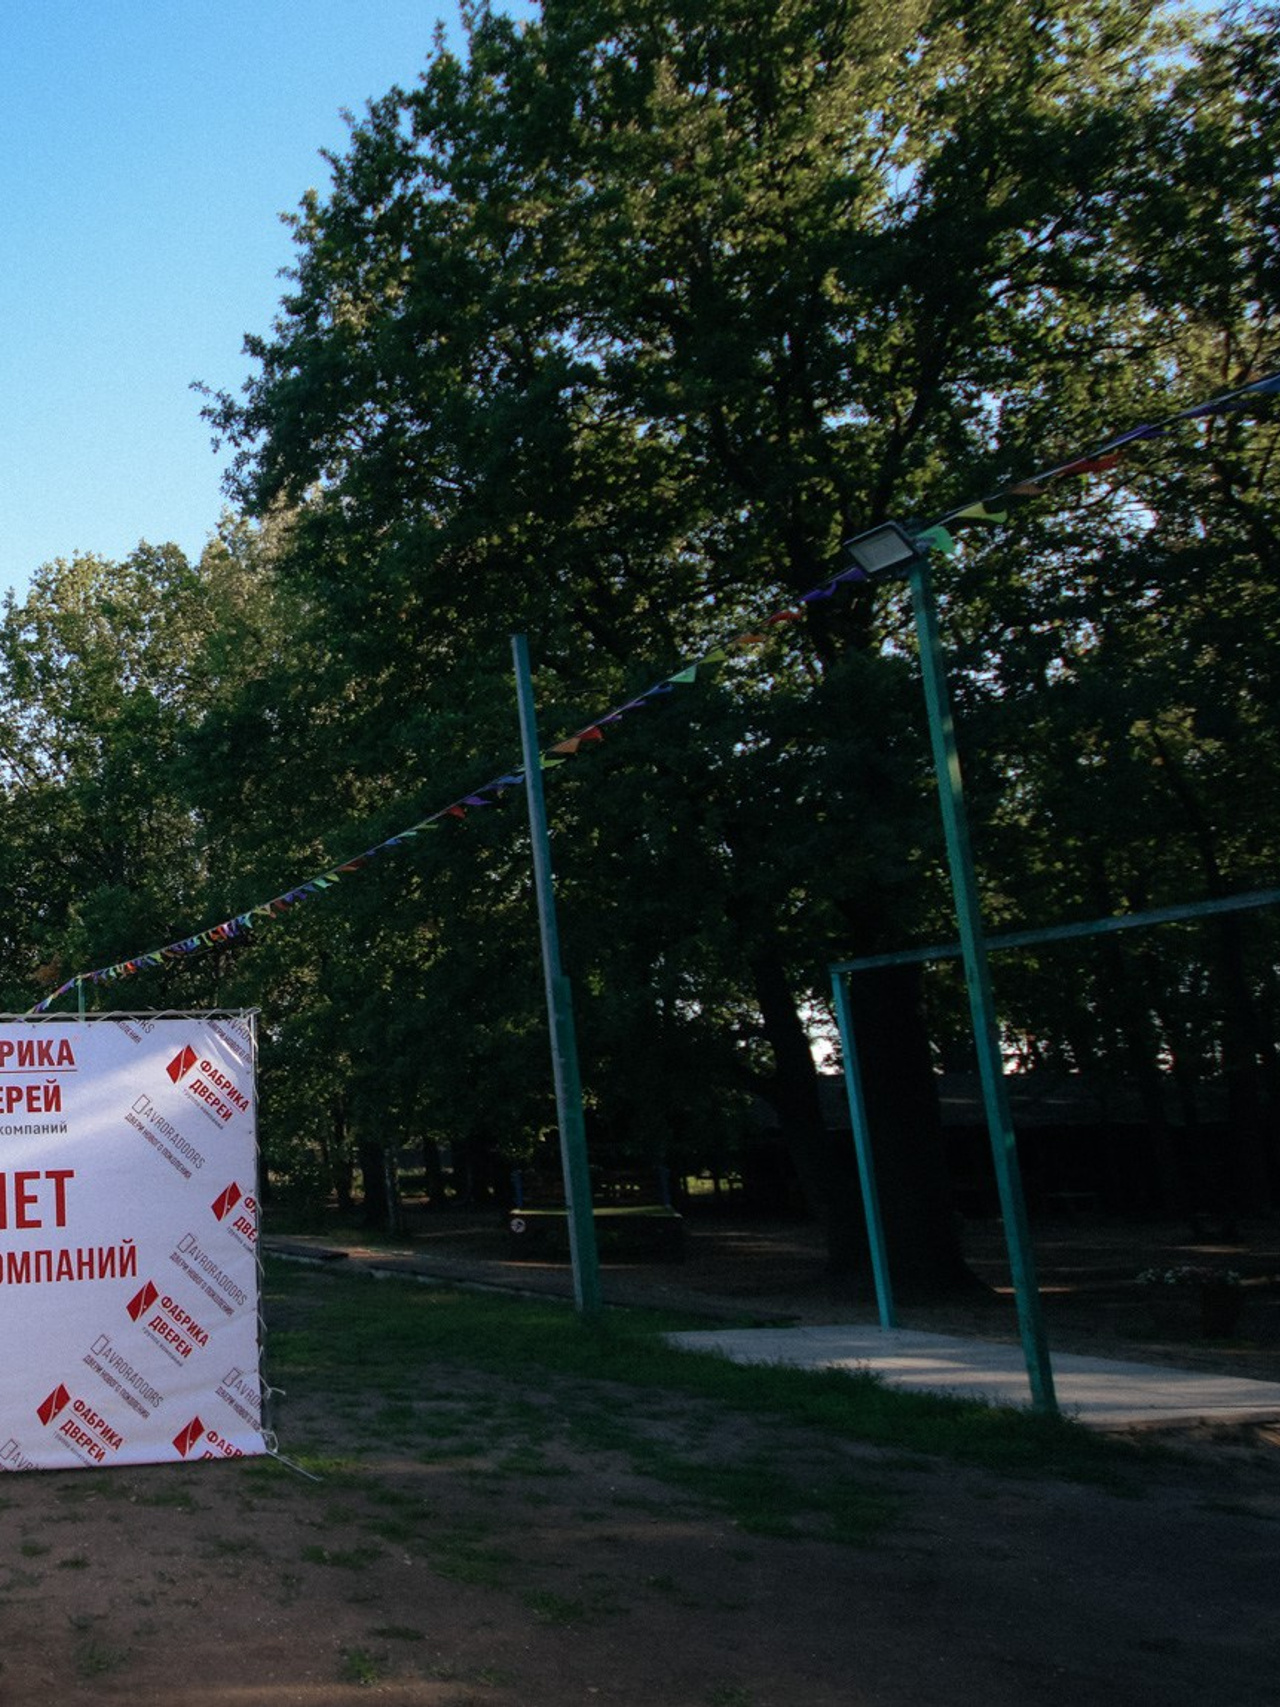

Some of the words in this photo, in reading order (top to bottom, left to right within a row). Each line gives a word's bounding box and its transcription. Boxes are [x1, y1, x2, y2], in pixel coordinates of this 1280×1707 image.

[189, 1079, 233, 1122] ДВЕРЕЙ
[200, 1060, 249, 1112] ФАБРИКА
[144, 1107, 205, 1169] AVRORADOORS
[188, 1245, 247, 1306] AVRORADOORS
[148, 1315, 193, 1358] ДВЕРЕЙ
[161, 1296, 209, 1347] ФАБРИКА
[102, 1347, 164, 1408] AVRORADOORS
[59, 1419, 106, 1462] ДВЕРЕЙ
[73, 1399, 123, 1450] ФАБРИКА
